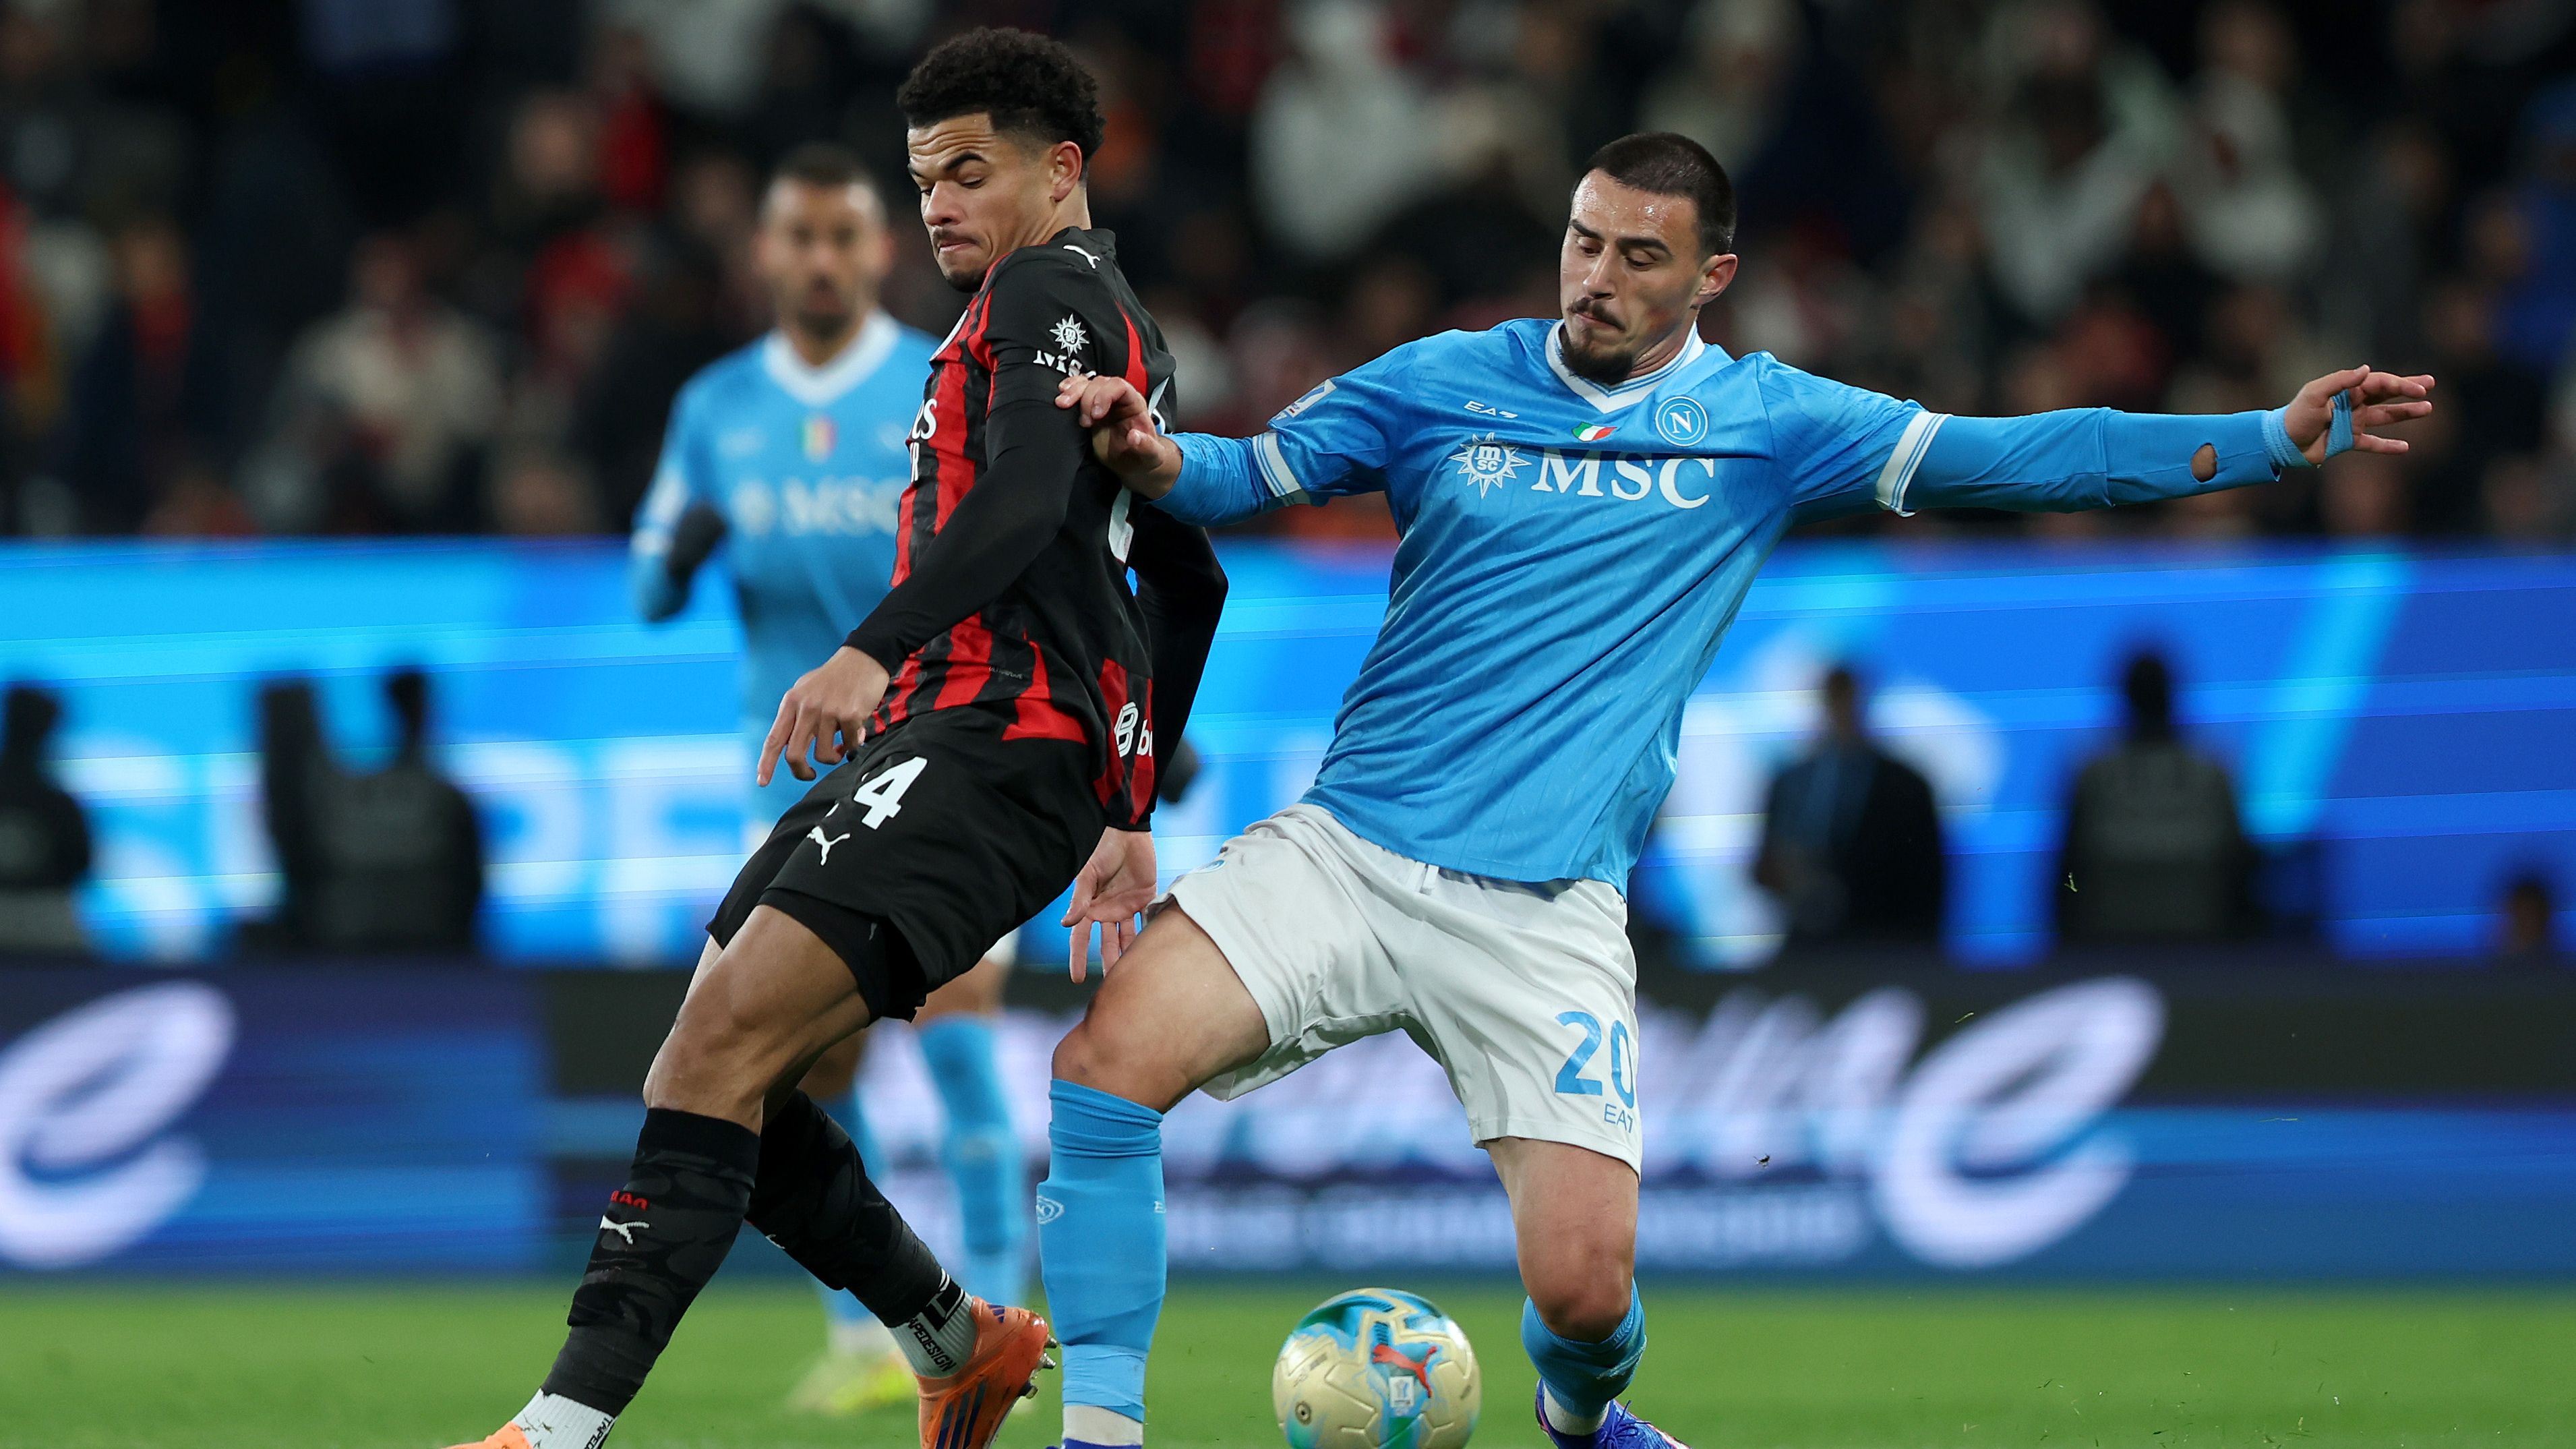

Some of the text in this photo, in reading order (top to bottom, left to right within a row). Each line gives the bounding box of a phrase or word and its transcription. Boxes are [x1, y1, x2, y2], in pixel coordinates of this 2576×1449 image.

[1530, 446, 1714, 509] MSC
[826, 756, 928, 830] 4
[1555, 1011, 1635, 1109] 20
